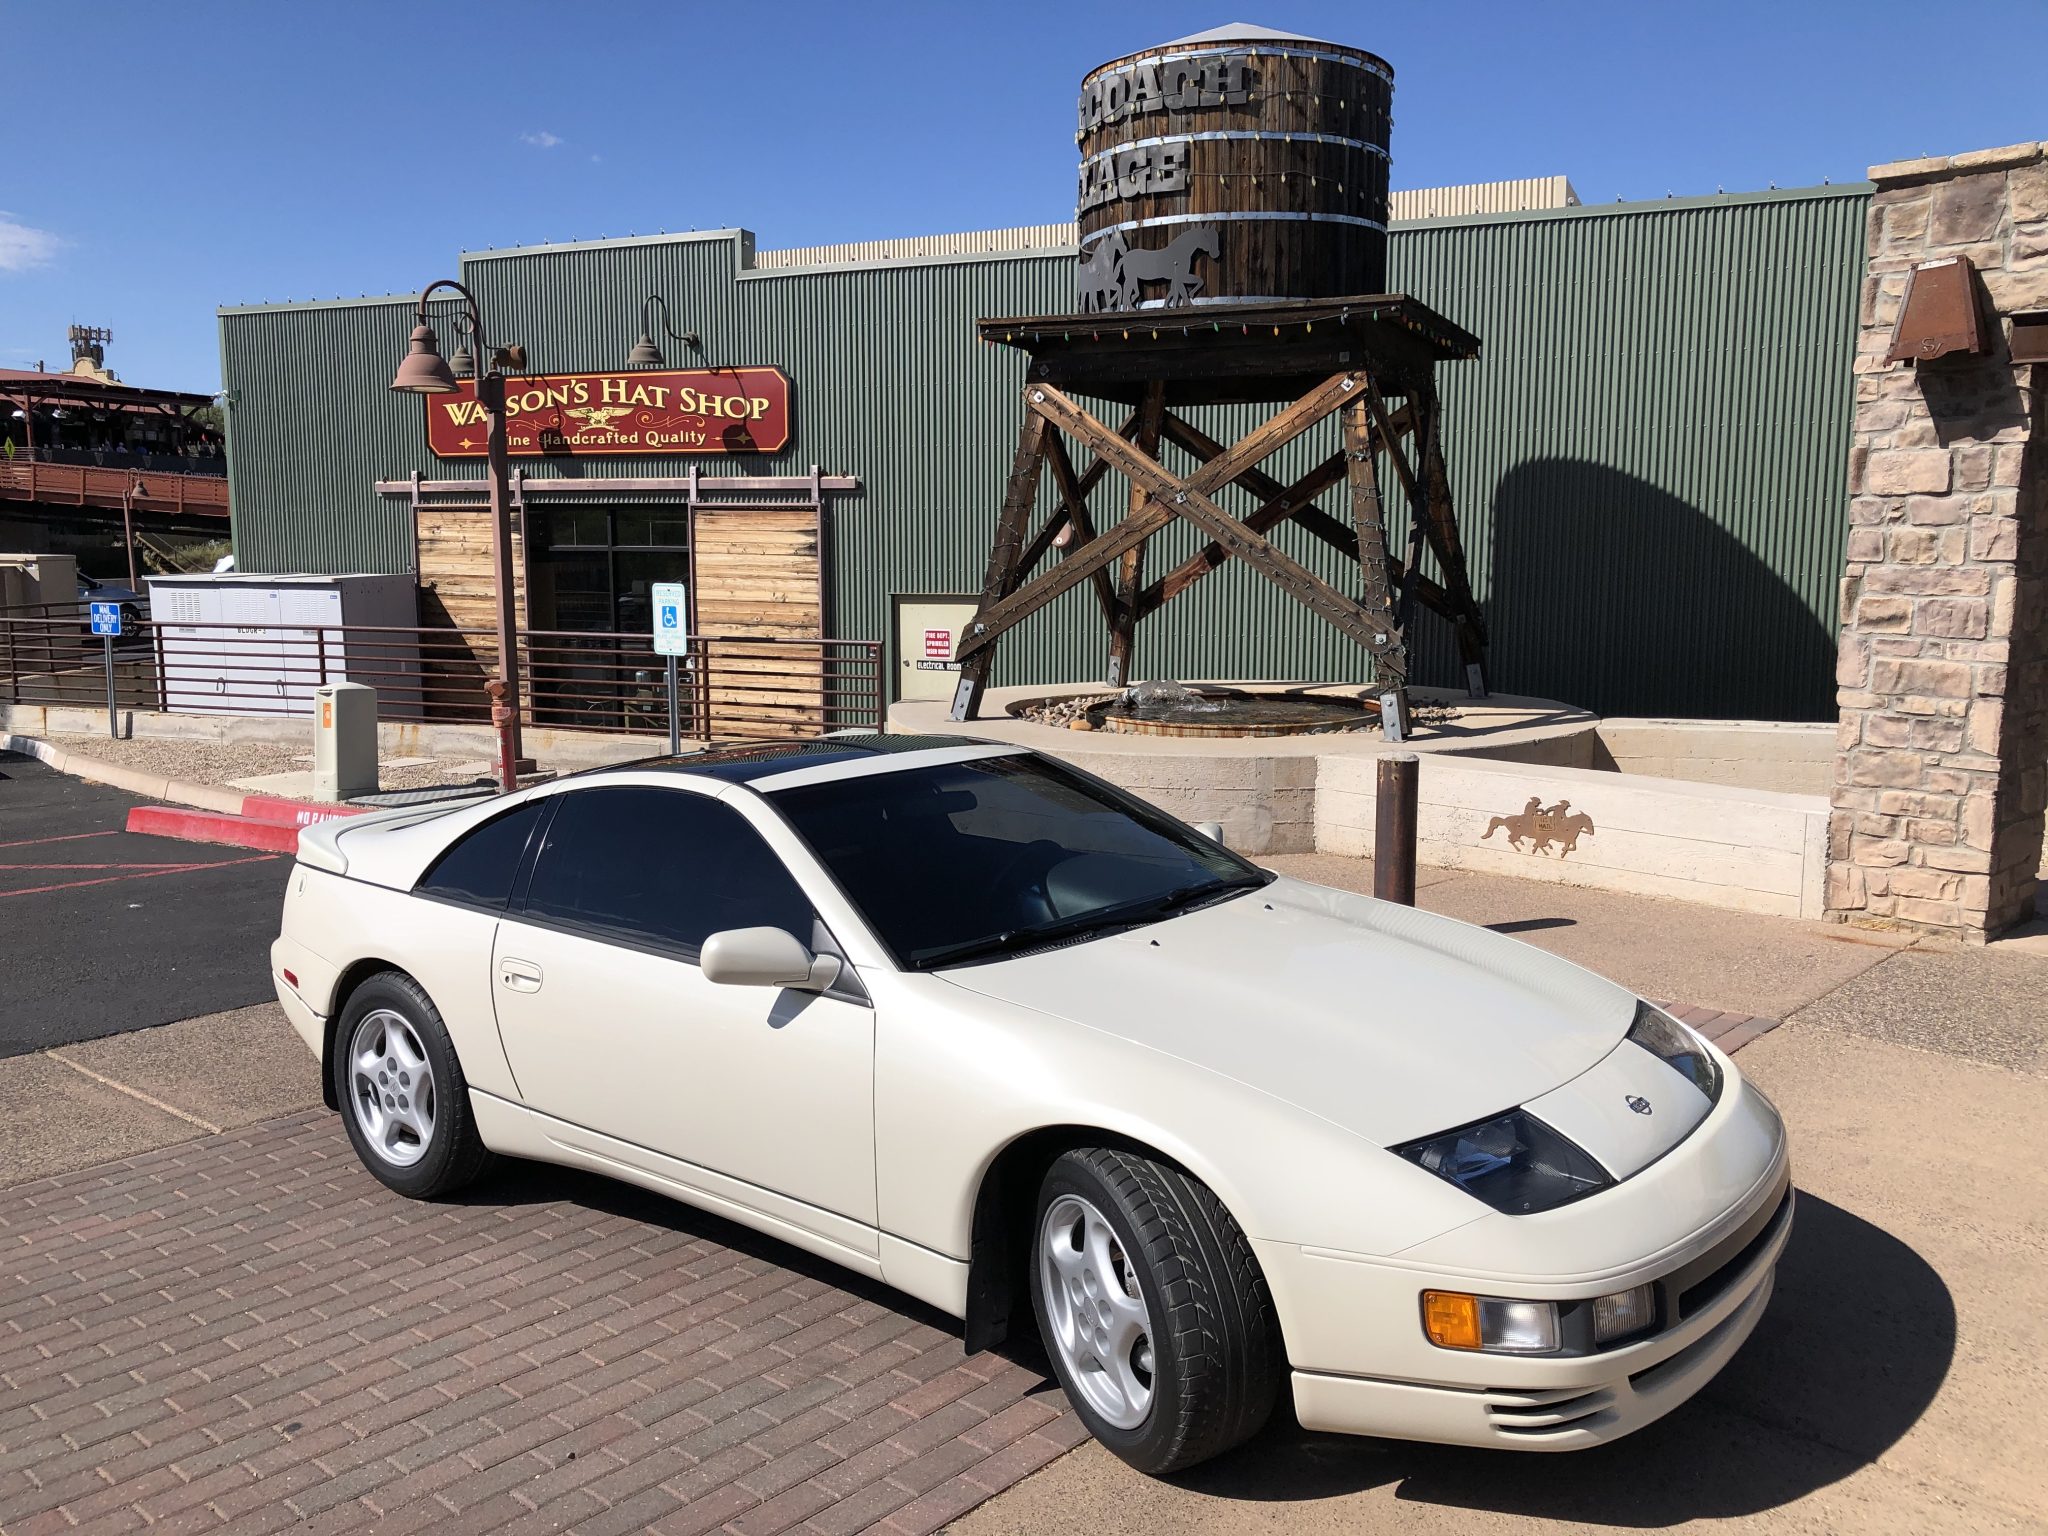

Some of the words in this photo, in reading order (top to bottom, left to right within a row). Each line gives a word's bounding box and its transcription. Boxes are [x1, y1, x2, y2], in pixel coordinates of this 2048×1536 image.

[443, 379, 589, 426] WASON'S
[600, 379, 670, 408] HAT
[680, 387, 769, 419] SHOP
[507, 433, 530, 446] ine
[537, 431, 638, 449] Handcrafted
[645, 430, 706, 447] Quality
[98, 604, 111, 614] MAIL
[94, 613, 117, 624] DELIVERY
[100, 623, 112, 633] ONLY
[297, 811, 310, 824] NO
